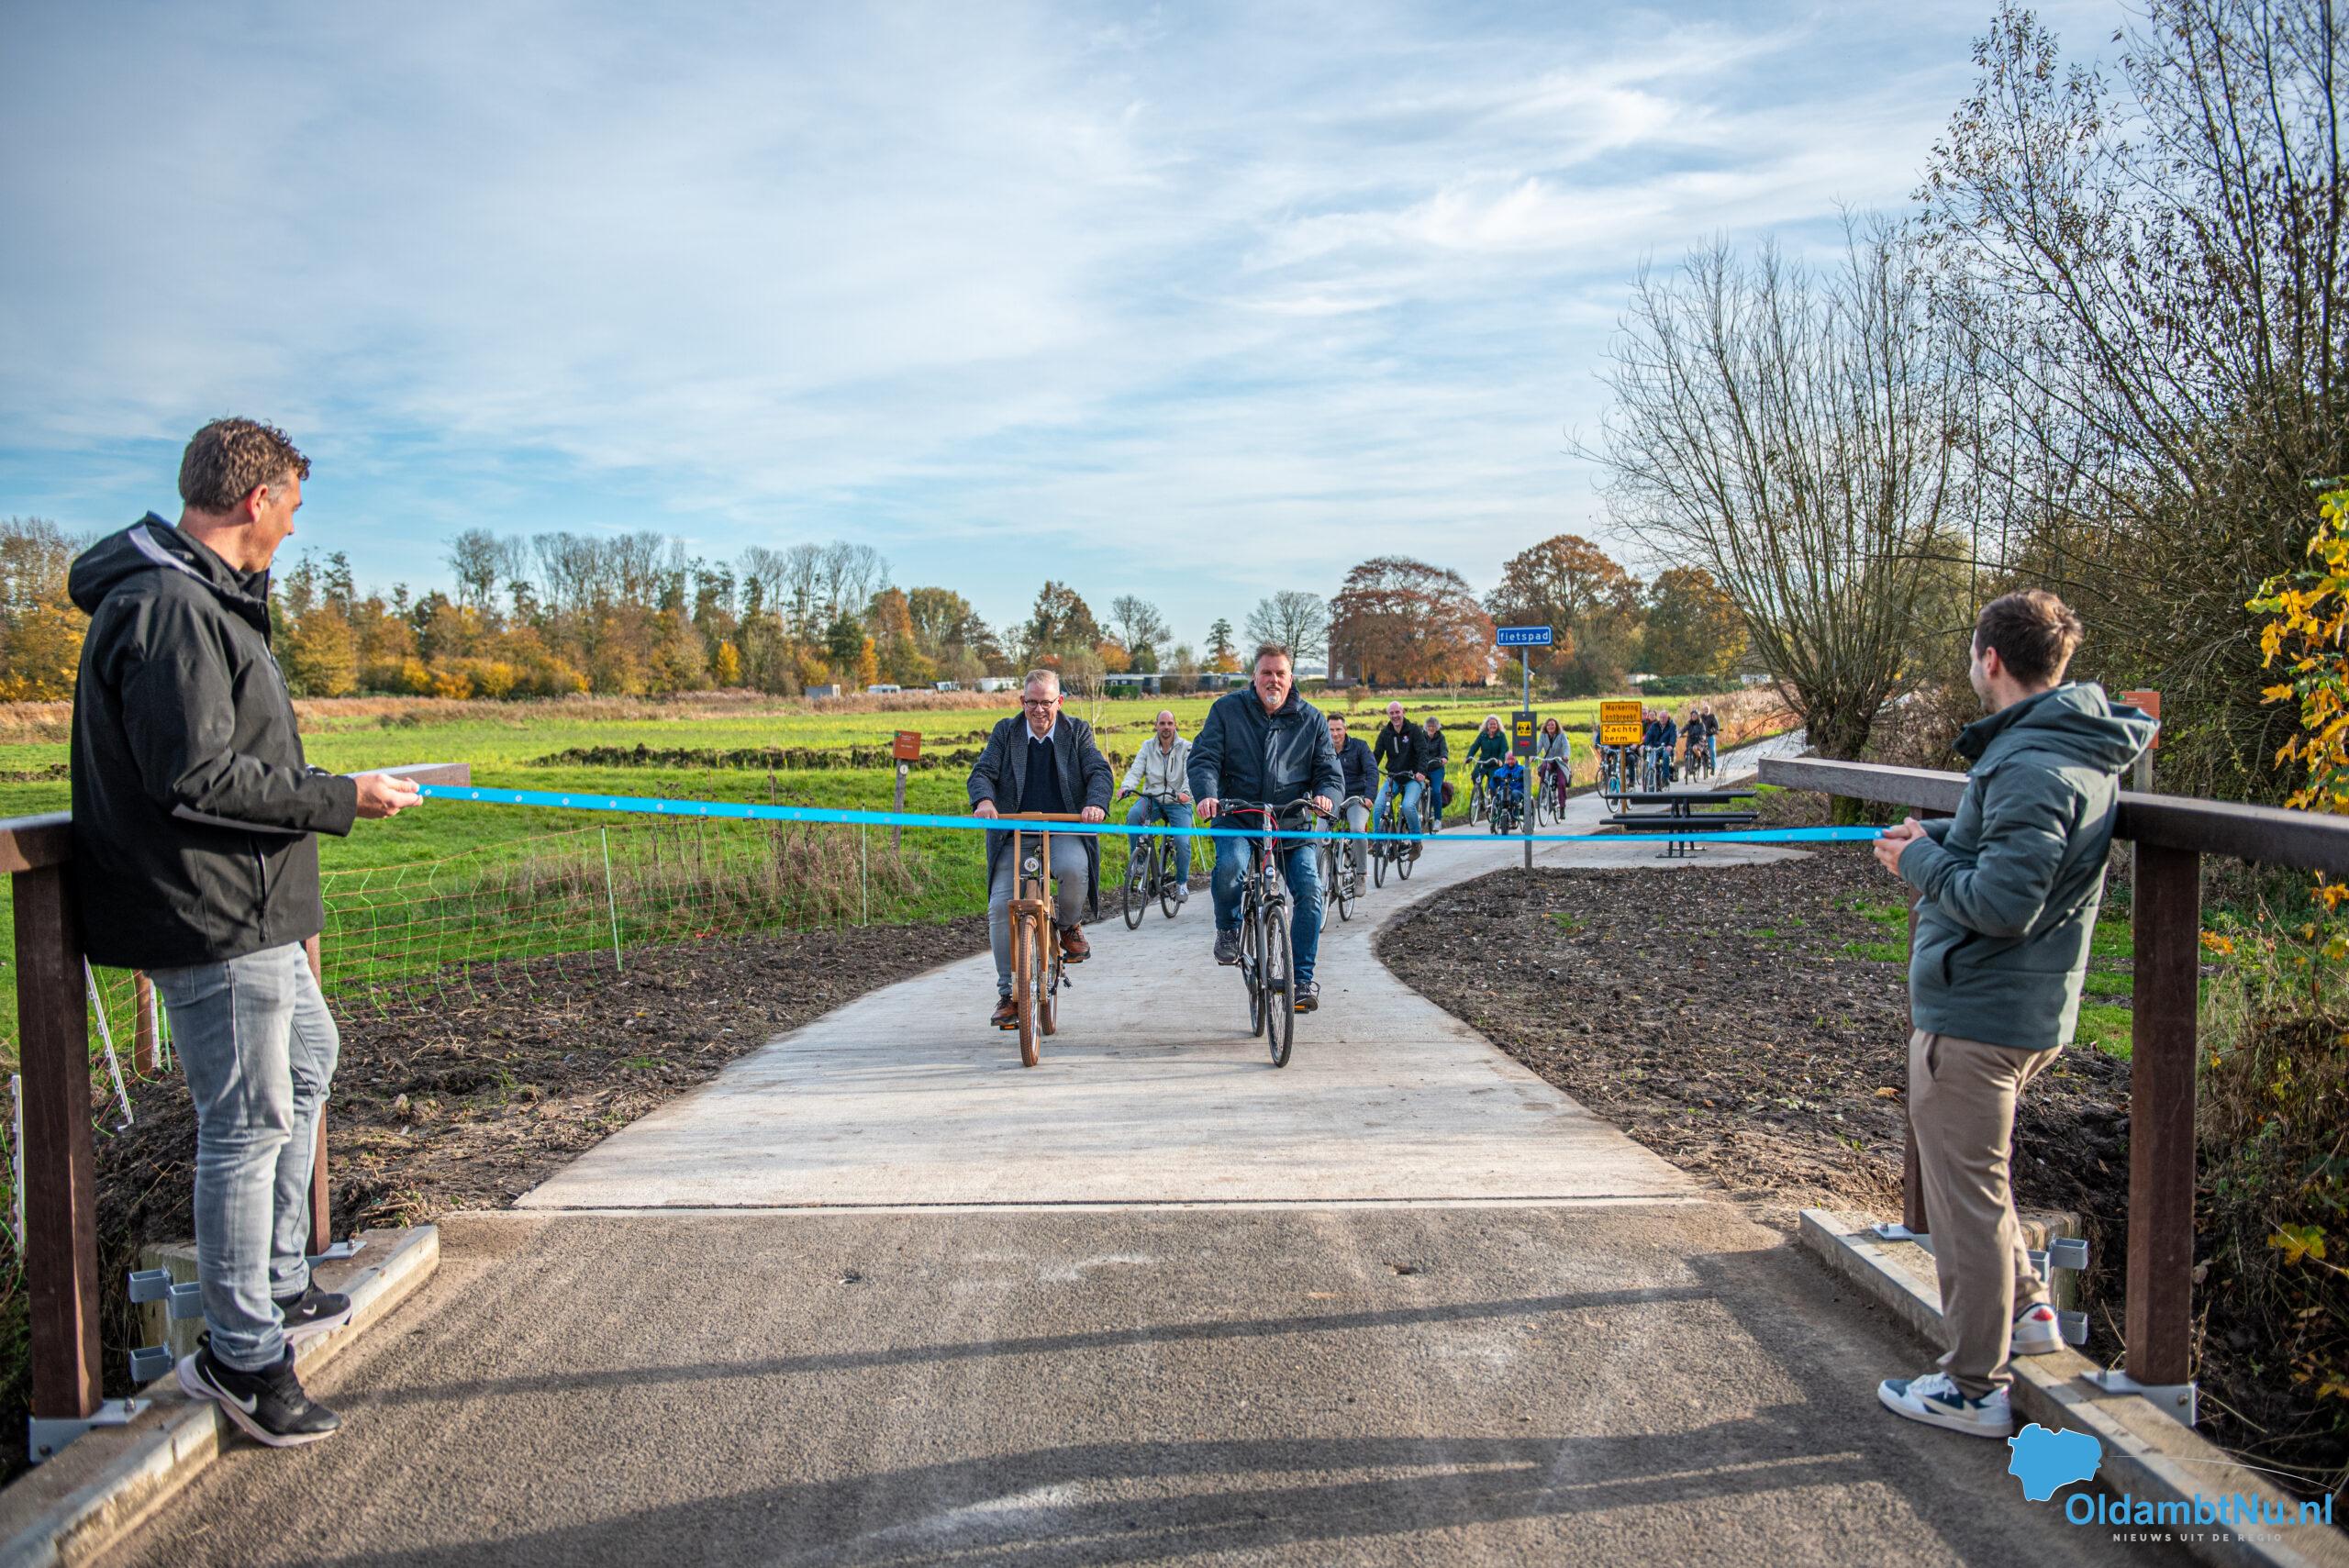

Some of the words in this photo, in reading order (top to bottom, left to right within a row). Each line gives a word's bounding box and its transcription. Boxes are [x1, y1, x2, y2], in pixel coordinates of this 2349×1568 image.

[1500, 631, 1549, 642] fietspad
[1605, 704, 1639, 712] Markering
[1605, 713, 1637, 721] ontbreekt
